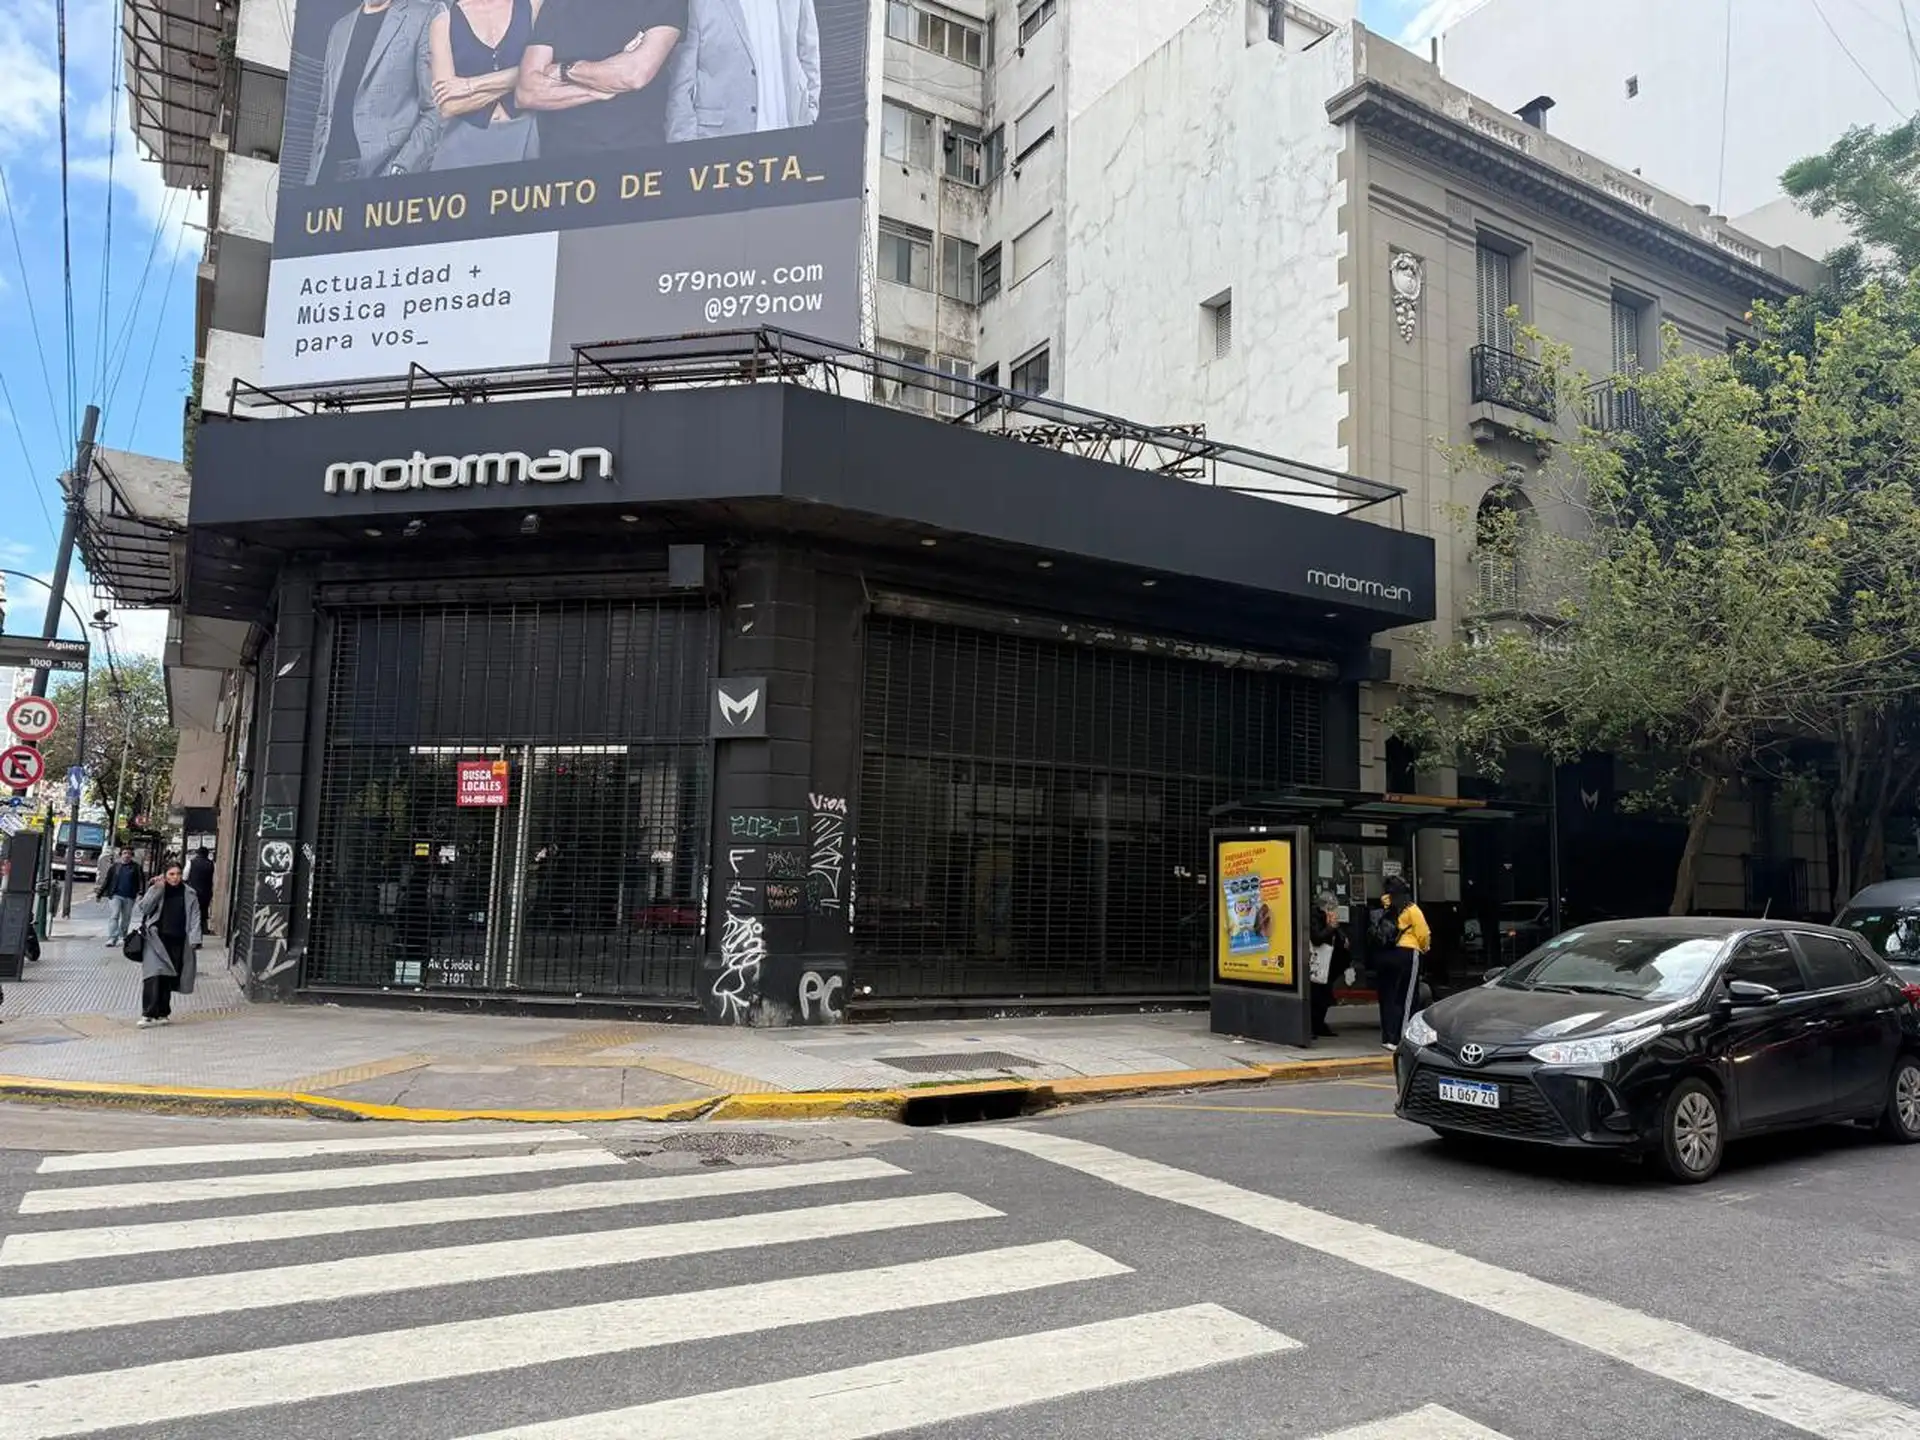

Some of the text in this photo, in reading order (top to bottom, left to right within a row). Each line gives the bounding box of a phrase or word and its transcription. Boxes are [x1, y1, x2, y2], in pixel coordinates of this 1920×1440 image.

[305, 206, 343, 234] UN
[365, 193, 467, 229] NUEVO
[490, 178, 597, 215] PUNTO
[620, 171, 663, 200] DE
[300, 264, 451, 296] Actualidad
[658, 263, 823, 294] 979now.com
[297, 288, 512, 325] Música pensada
[704, 293, 823, 323] @979now
[295, 333, 353, 357] para
[324, 446, 612, 493] motorman
[1306, 568, 1412, 603] motorman
[47, 639, 86, 651] Agüero
[29, 658, 53, 668] 1000
[61, 660, 84, 670] 1100
[17, 707, 47, 728] 50
[462, 768, 492, 781] BUSCA
[462, 780, 502, 792] LOCALES
[441, 971, 465, 984] 3101
[1457, 1087, 1478, 1102] 067
